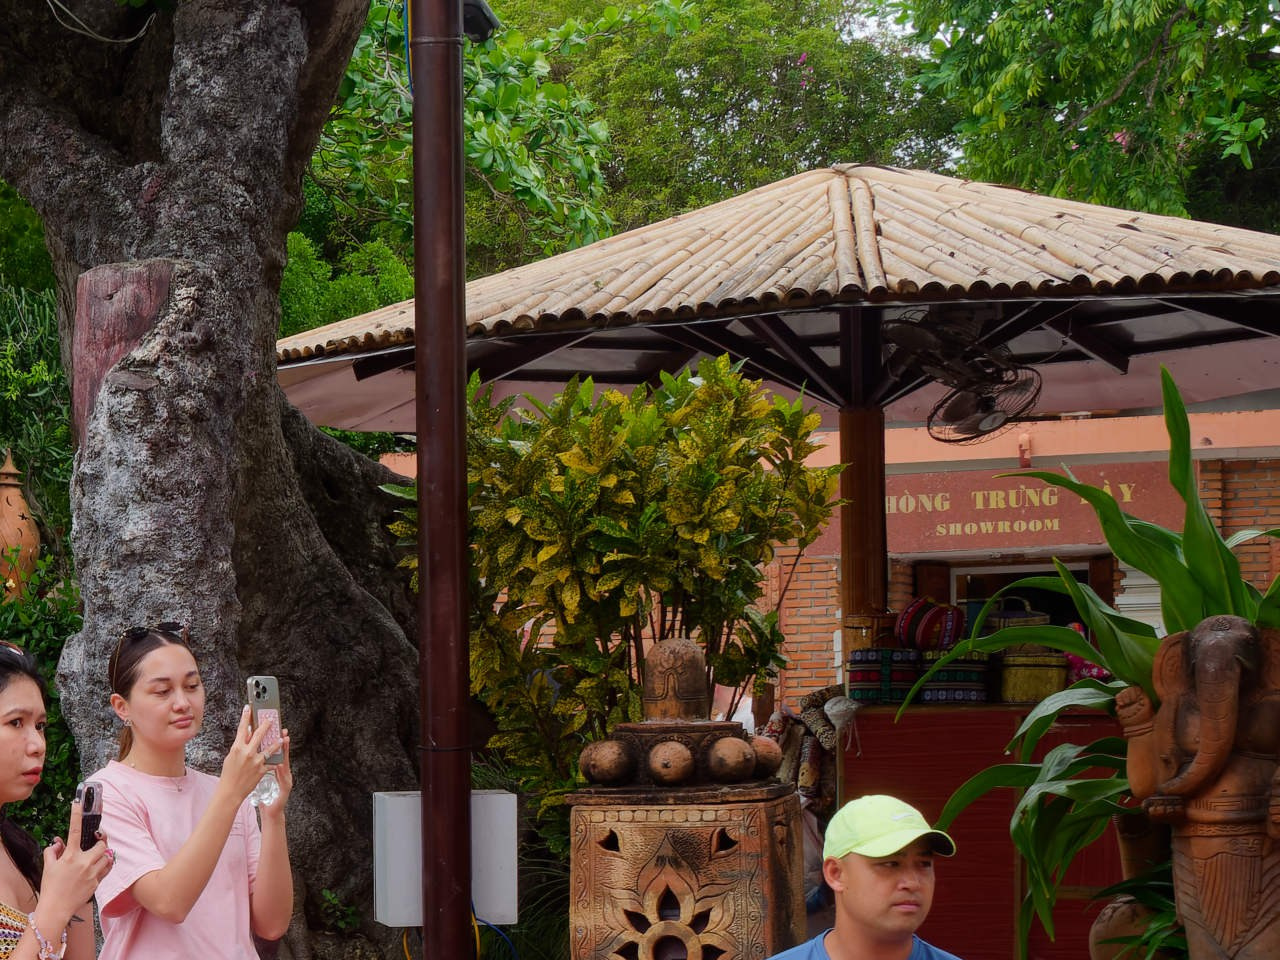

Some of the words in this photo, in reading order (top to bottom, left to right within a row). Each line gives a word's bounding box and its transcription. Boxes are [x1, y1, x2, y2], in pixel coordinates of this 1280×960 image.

[885, 489, 951, 514] HÒNG
[971, 484, 1059, 510] TRƯNG
[935, 518, 1061, 536] SHOWROOM
